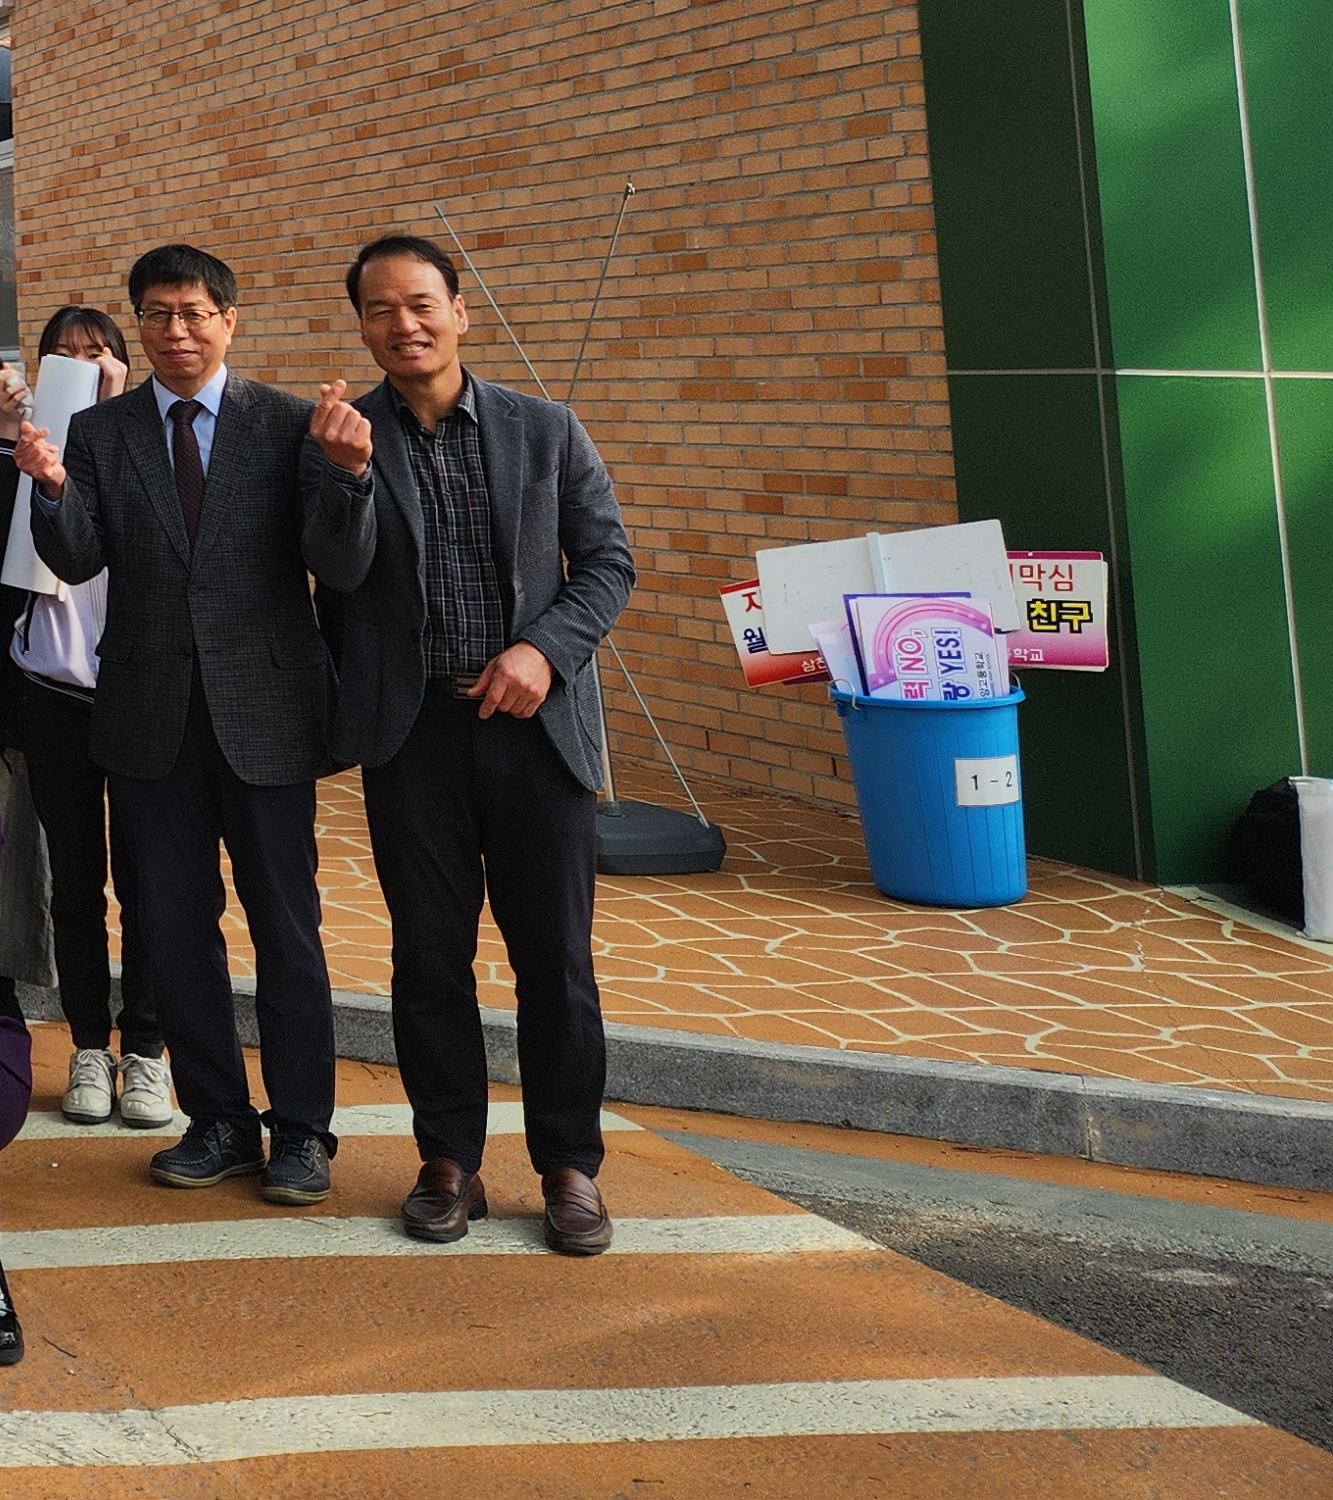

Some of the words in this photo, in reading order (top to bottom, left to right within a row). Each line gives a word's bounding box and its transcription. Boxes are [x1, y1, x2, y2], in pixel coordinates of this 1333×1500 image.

[1009, 563, 1074, 592] 막심
[1027, 599, 1093, 633] 친구
[896, 630, 926, 672] NO,
[933, 629, 965, 676] YES!
[1007, 648, 1044, 662] 학교
[974, 651, 991, 698] 앙고등학교
